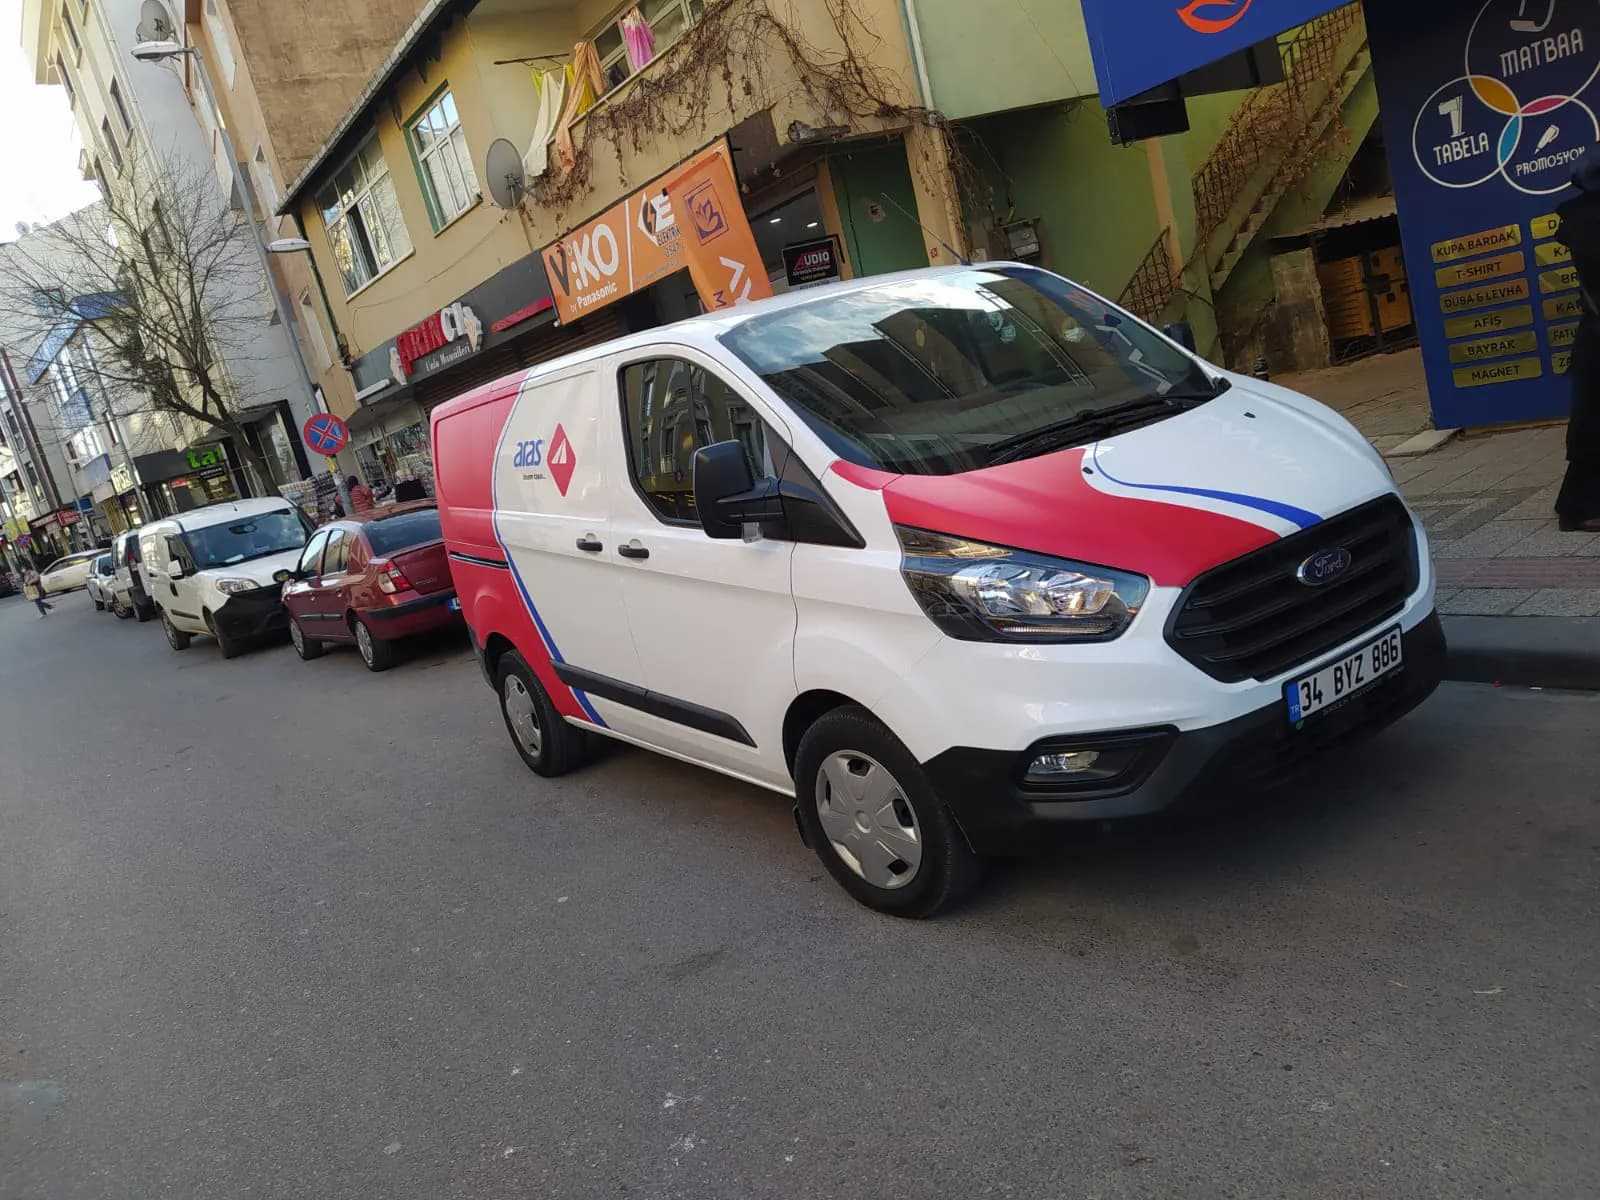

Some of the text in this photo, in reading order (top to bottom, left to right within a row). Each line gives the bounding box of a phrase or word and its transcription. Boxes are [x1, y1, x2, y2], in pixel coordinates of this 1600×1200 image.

[1500, 28, 1584, 77] MATBAA
[1433, 132, 1489, 166] TABELA
[1436, 229, 1514, 257] KUPA BARDAK
[1456, 262, 1501, 279] T-SHIRT
[576, 281, 618, 309] Panasonic
[1445, 294, 1474, 308] DUBA
[1486, 285, 1523, 301] LEVHA
[1467, 339, 1516, 356] BAYRAK
[1471, 365, 1521, 381] MAGNET
[513, 439, 545, 468] aras
[1314, 552, 1344, 578] Ford
[1300, 677, 1323, 712] 34
[1334, 654, 1365, 696] BYZ
[1372, 633, 1399, 674] 886
